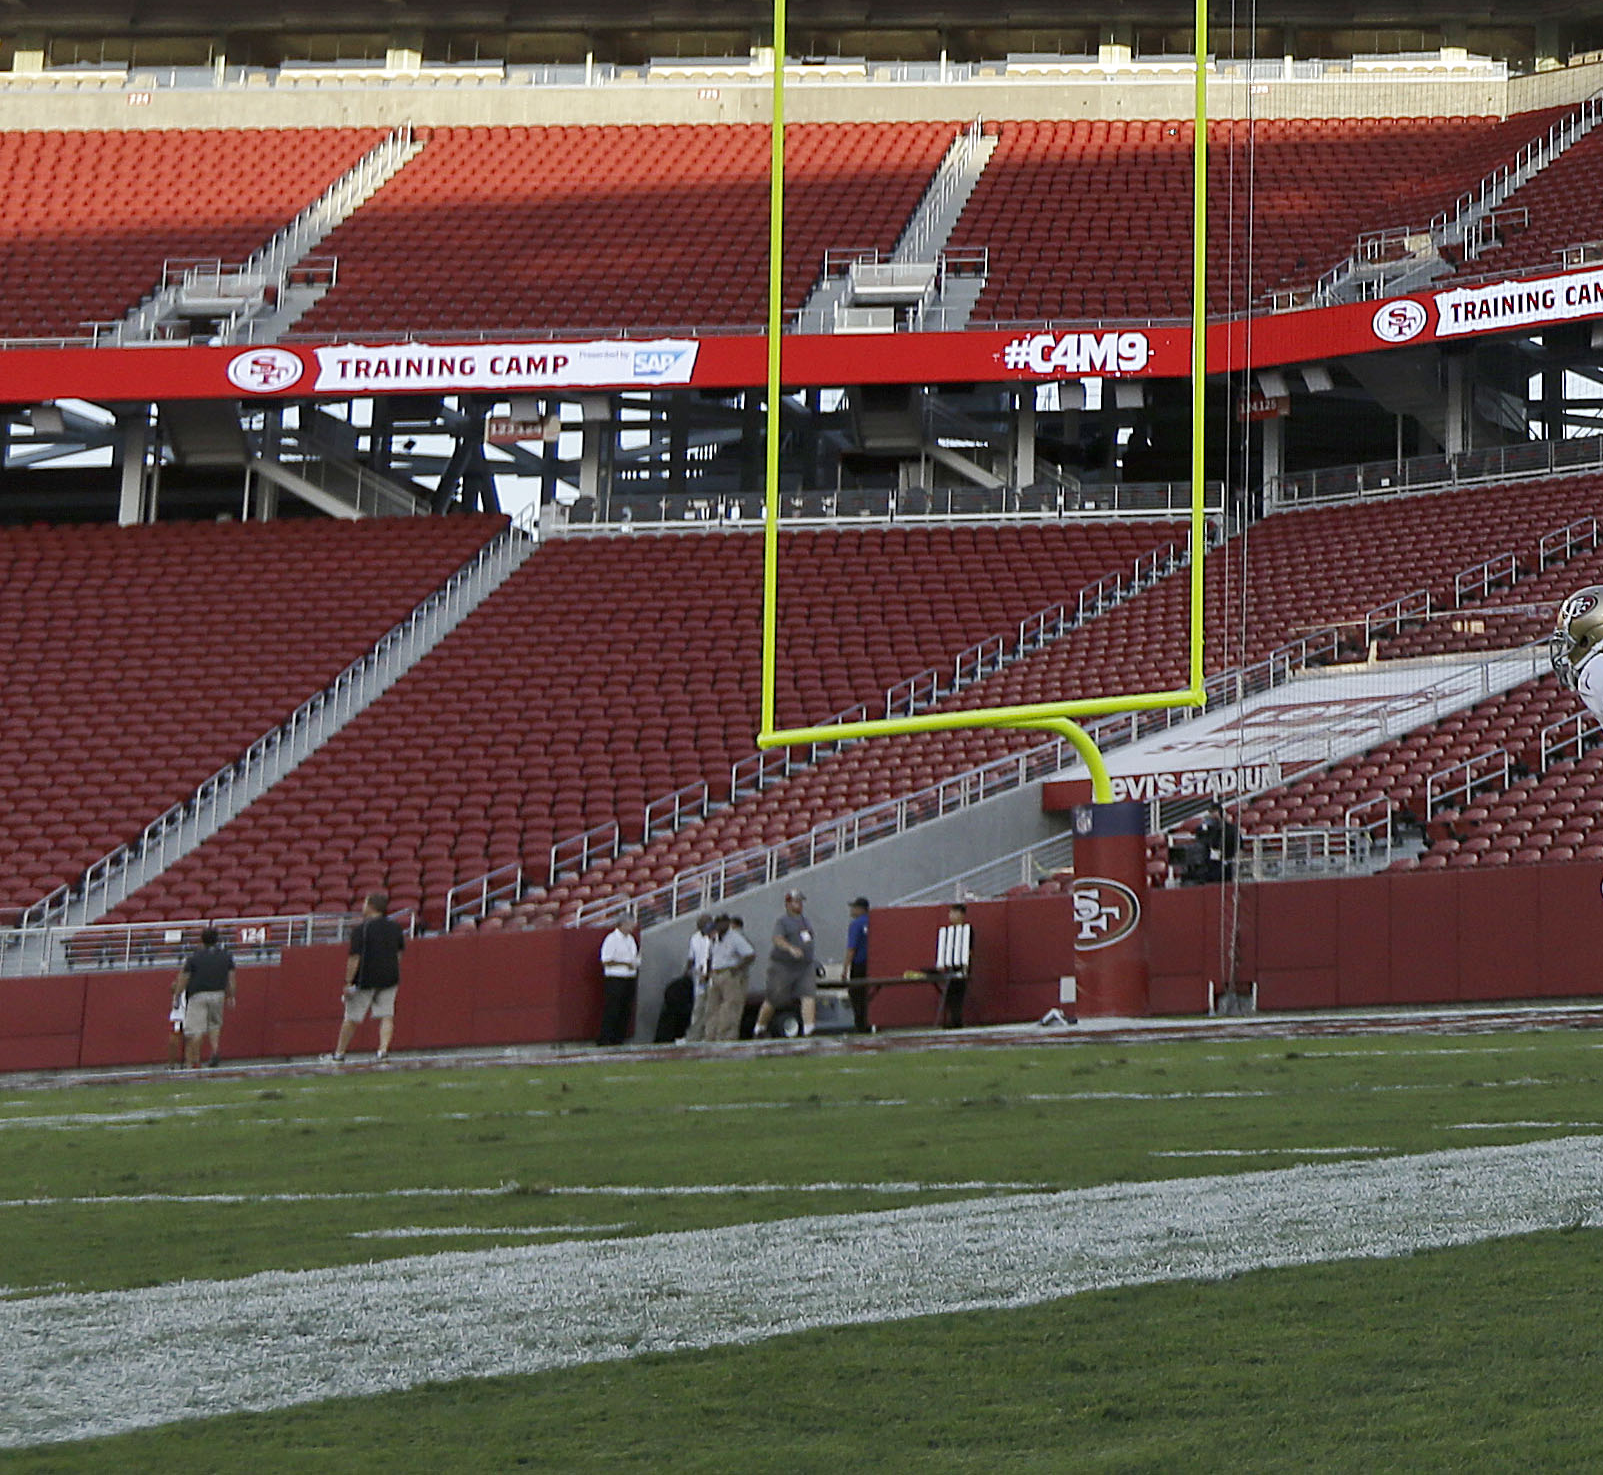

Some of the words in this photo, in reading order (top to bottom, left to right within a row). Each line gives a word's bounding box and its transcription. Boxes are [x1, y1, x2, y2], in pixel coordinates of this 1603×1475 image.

[1450, 289, 1555, 323] TRAINING
[336, 356, 475, 379] TRAINING
[489, 354, 570, 376] CAMP
[634, 352, 676, 372] SAP
[1004, 331, 1148, 374] #C4M9
[1180, 765, 1283, 797] STADIUM
